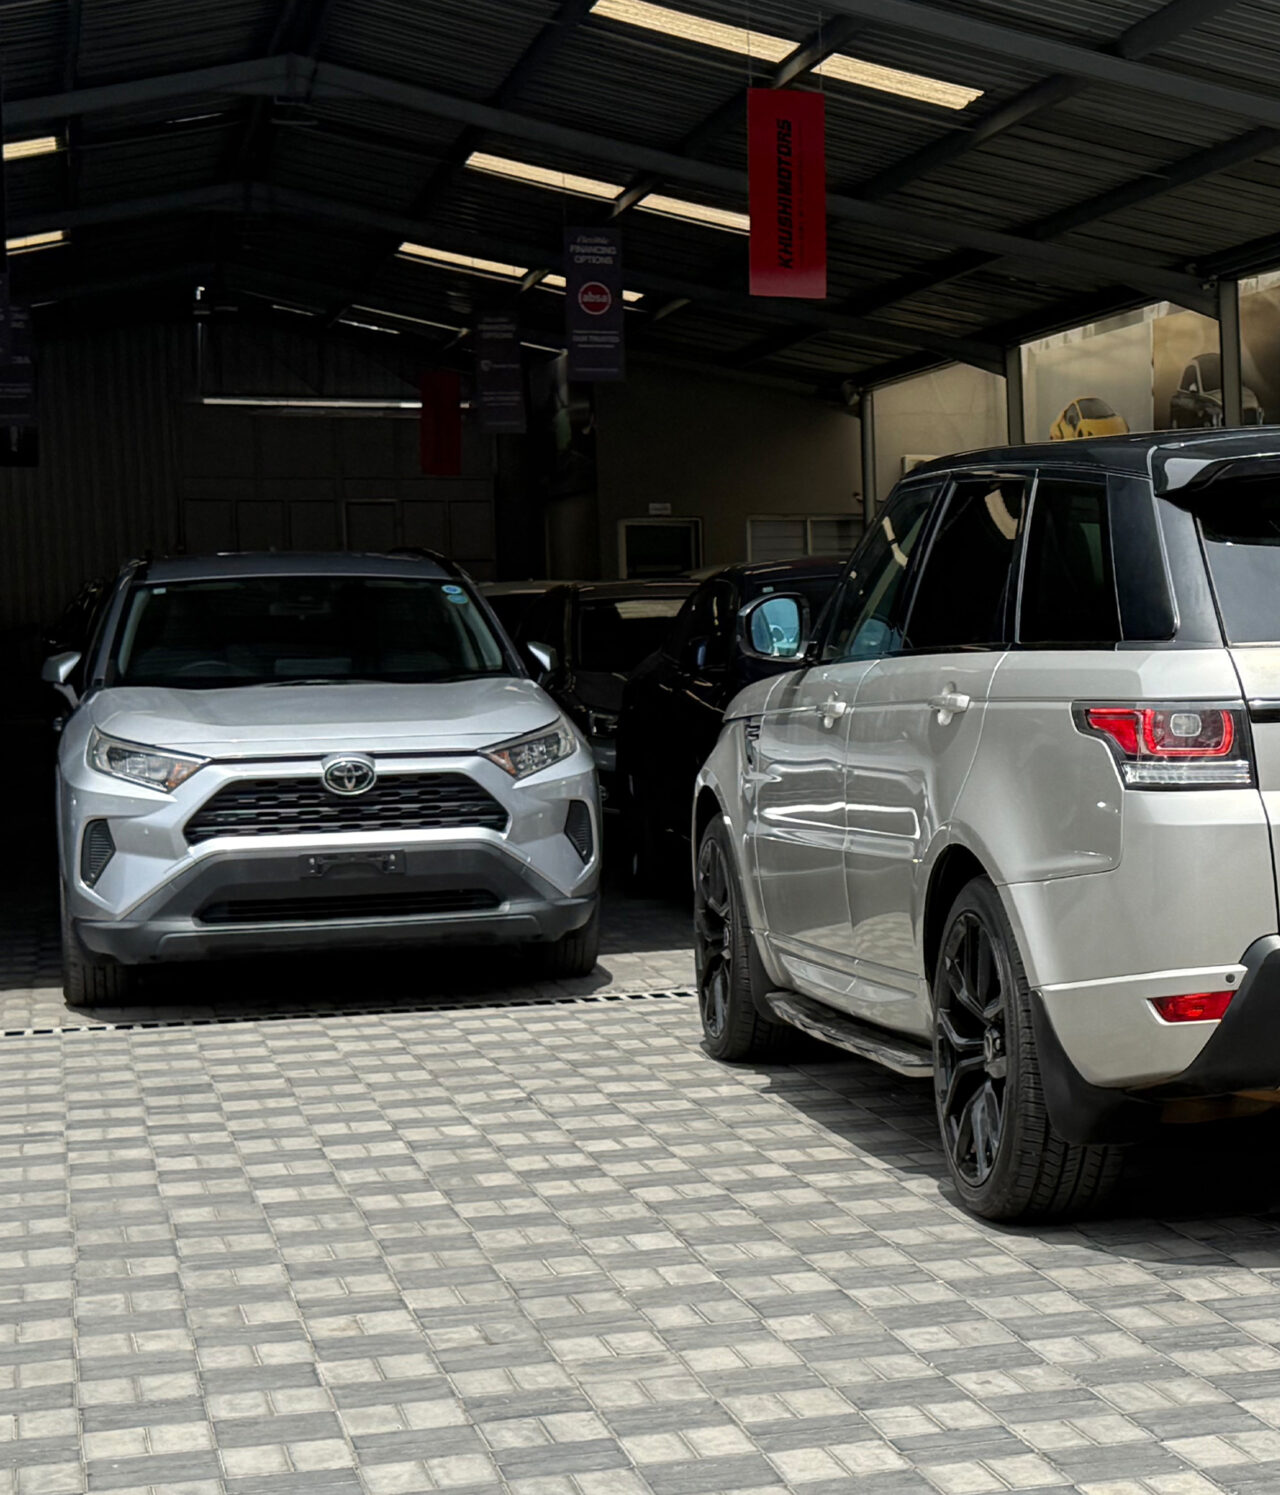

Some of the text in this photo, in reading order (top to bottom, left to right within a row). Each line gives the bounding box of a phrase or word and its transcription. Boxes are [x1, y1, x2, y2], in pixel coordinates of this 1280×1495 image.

[777, 118, 793, 270] KHUSHIMOTORS
[569, 244, 617, 254] FINANCING
[574, 255, 614, 265] OPTIONS
[582, 291, 609, 303] absa
